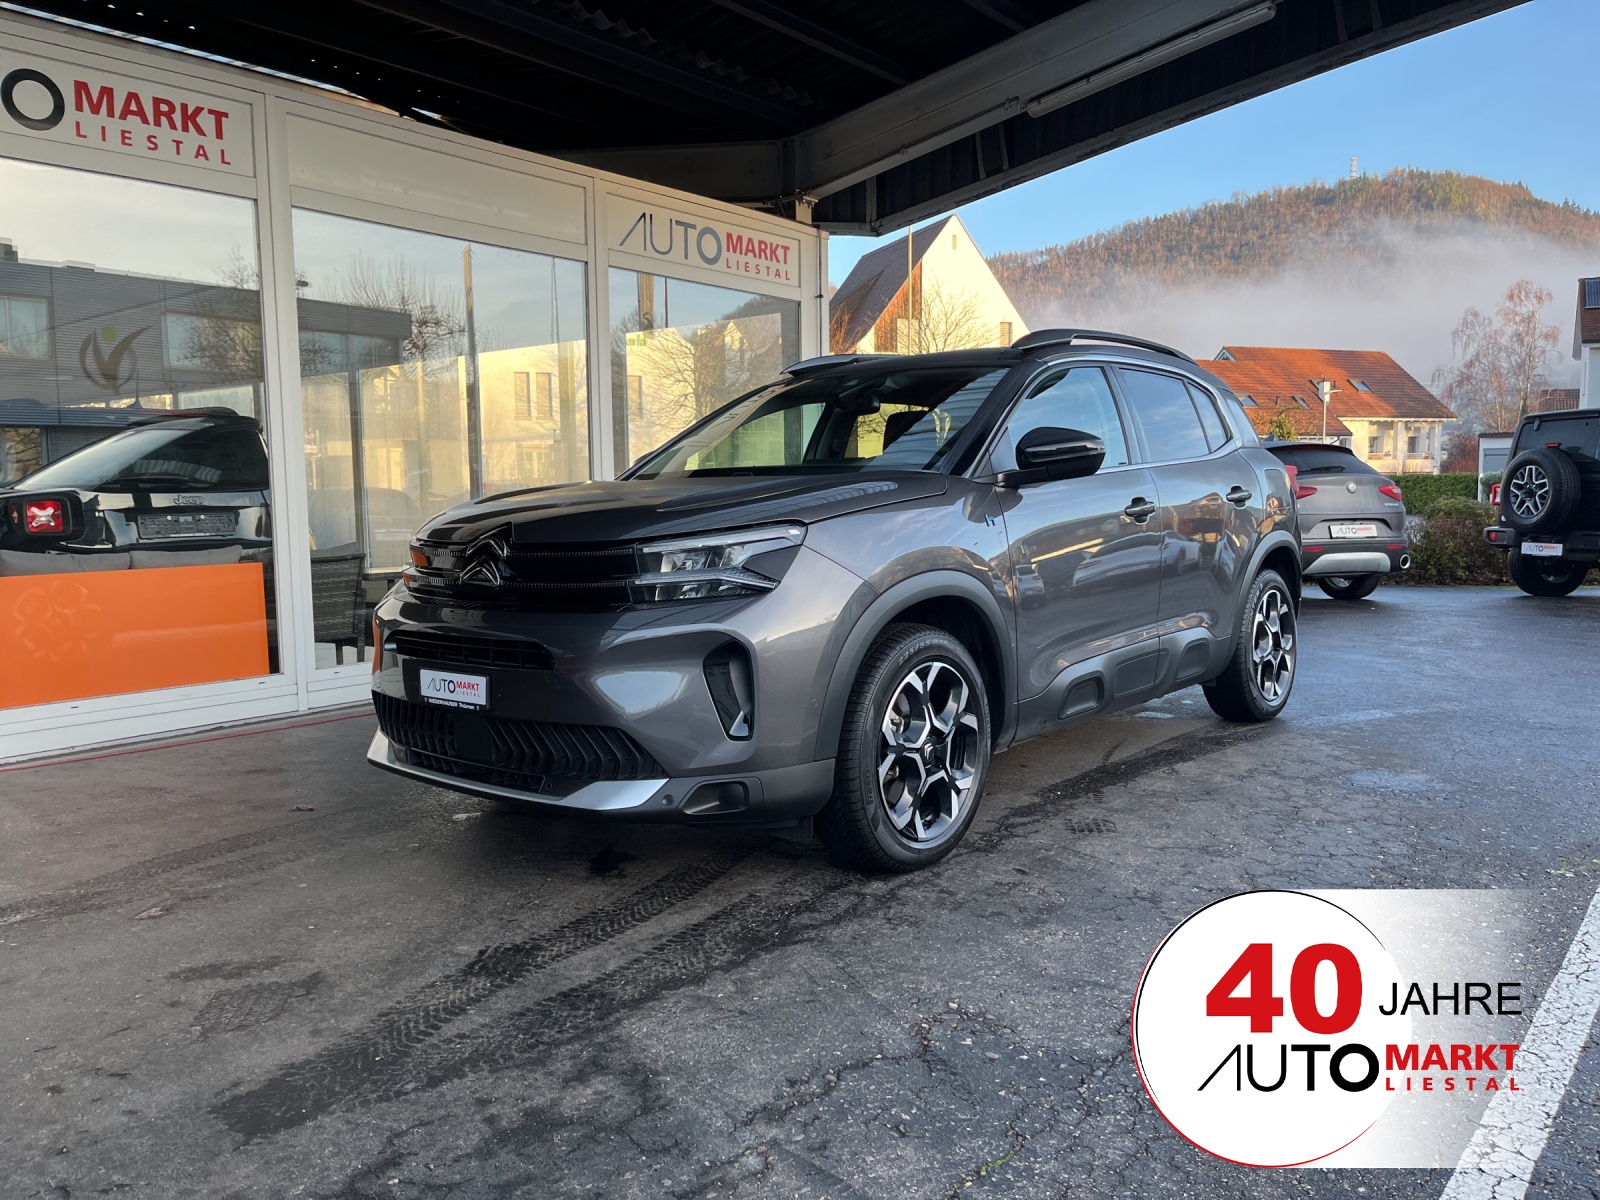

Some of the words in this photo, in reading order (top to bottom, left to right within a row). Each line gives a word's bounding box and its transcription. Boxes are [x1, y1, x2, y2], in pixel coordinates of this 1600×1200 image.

[74, 79, 229, 140] MARKT
[75, 121, 231, 165] LIESTAL
[726, 232, 790, 265] MARKT
[726, 258, 790, 281] LIESTAL
[173, 493, 204, 505] Jeep
[456, 680, 480, 691] MARKT
